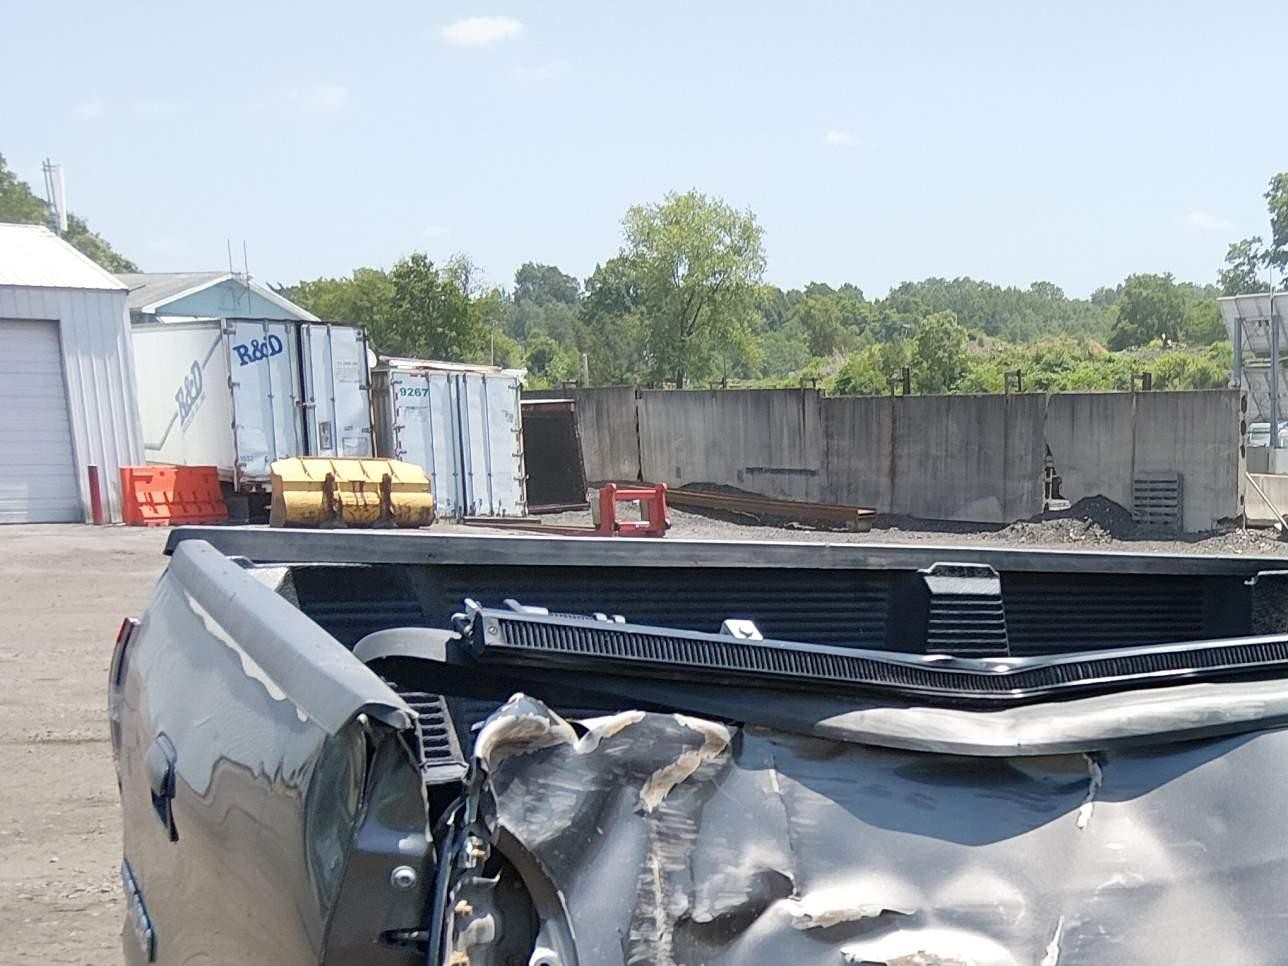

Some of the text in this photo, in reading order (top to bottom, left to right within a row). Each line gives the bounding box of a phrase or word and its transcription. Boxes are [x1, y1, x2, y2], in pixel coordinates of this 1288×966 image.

[233, 334, 283, 366] R&D
[175, 360, 203, 427] R&D
[399, 387, 429, 397] 9267
